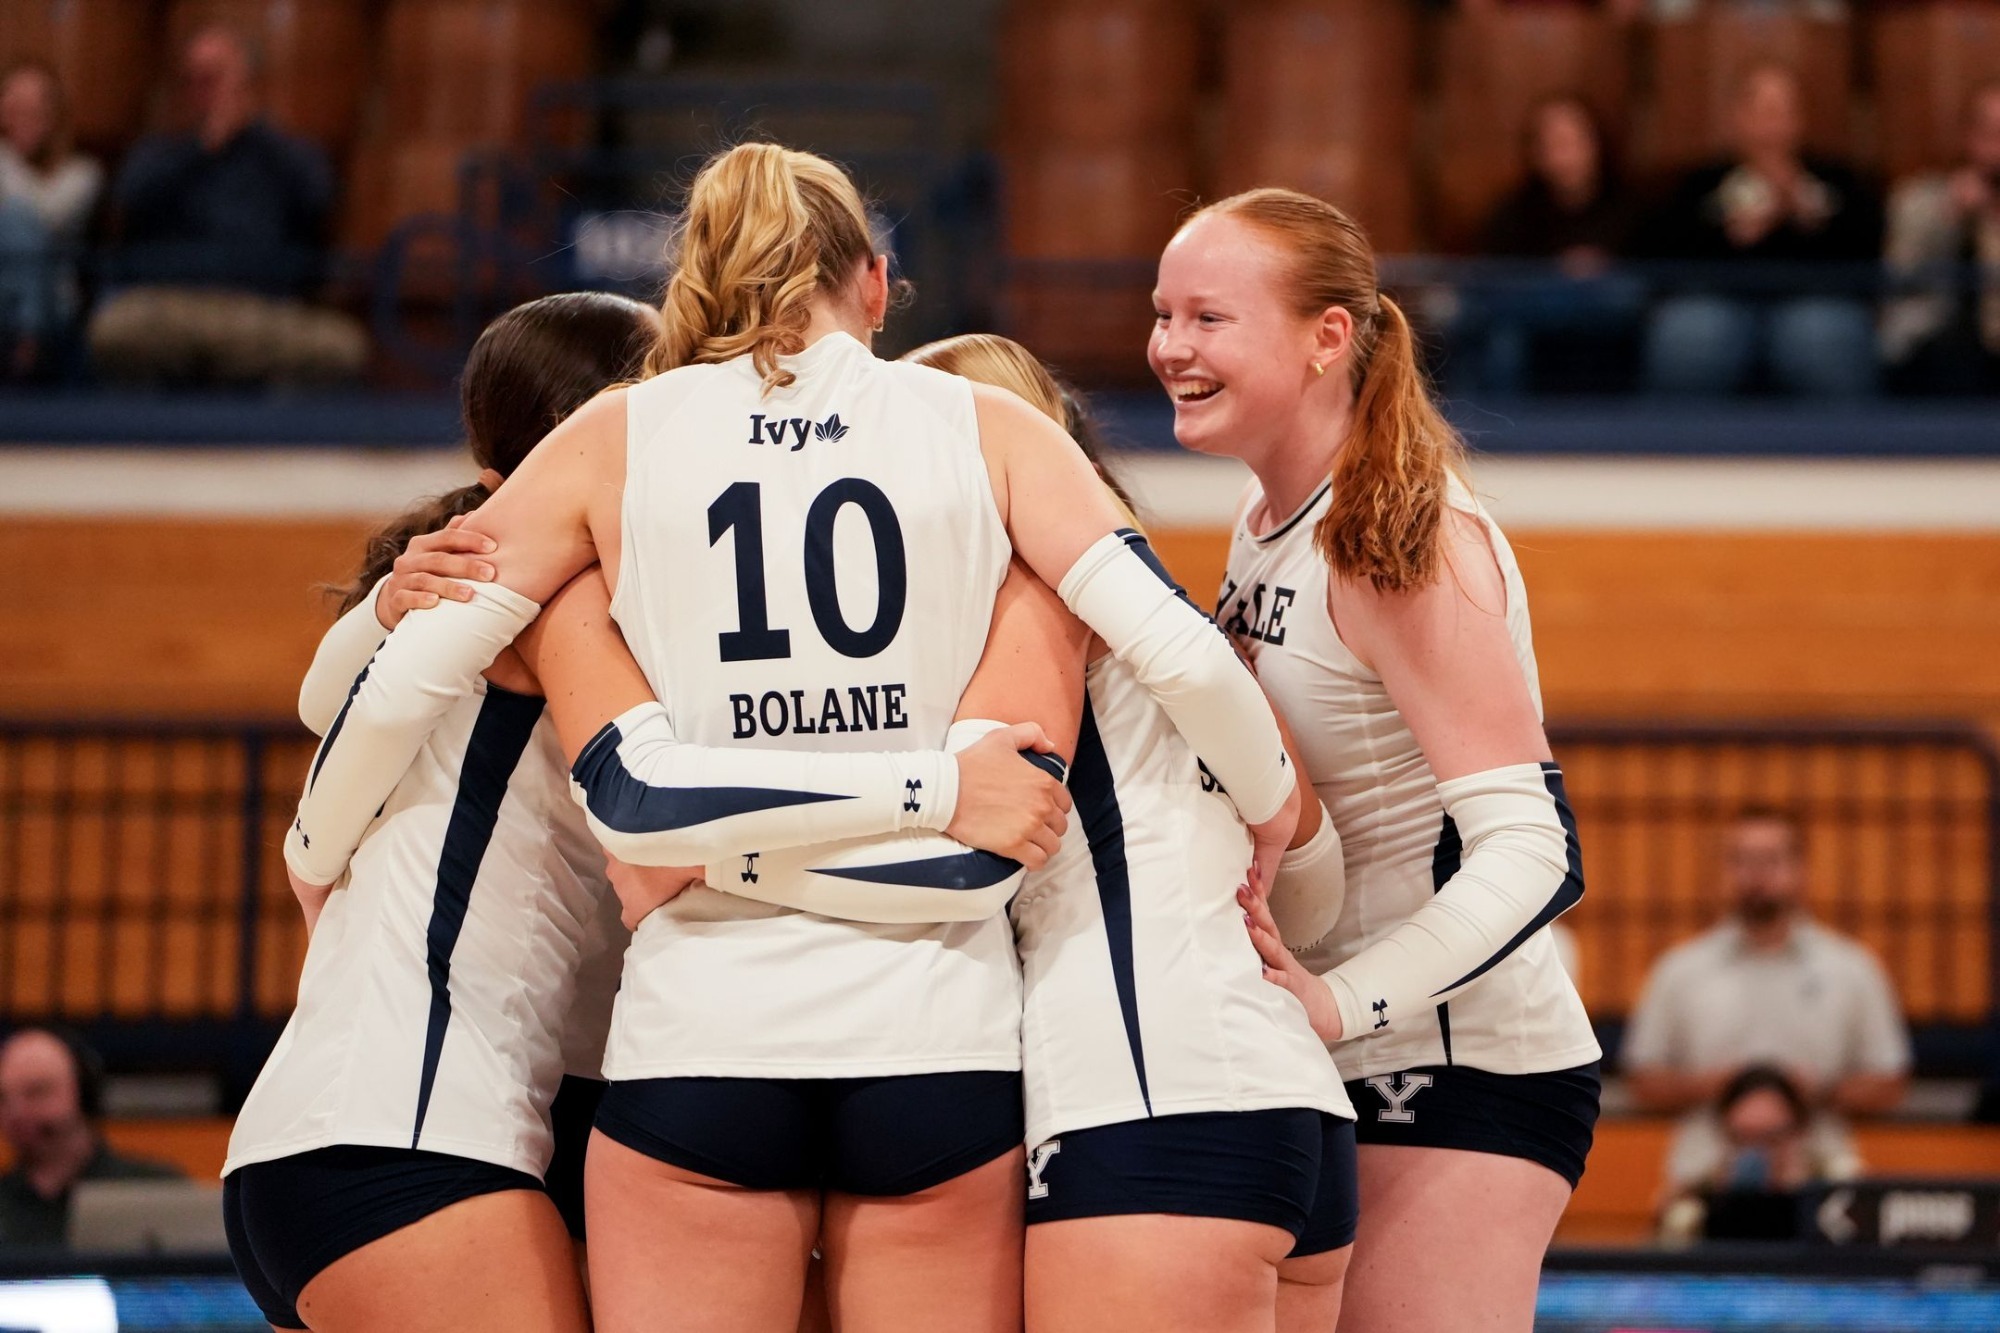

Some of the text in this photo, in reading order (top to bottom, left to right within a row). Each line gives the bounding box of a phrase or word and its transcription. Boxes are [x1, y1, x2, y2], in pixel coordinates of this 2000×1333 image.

[748, 414, 812, 452] Ivy
[707, 477, 907, 662] 10
[729, 684, 908, 739] BOLANE
[1365, 1072, 1433, 1123] Y
